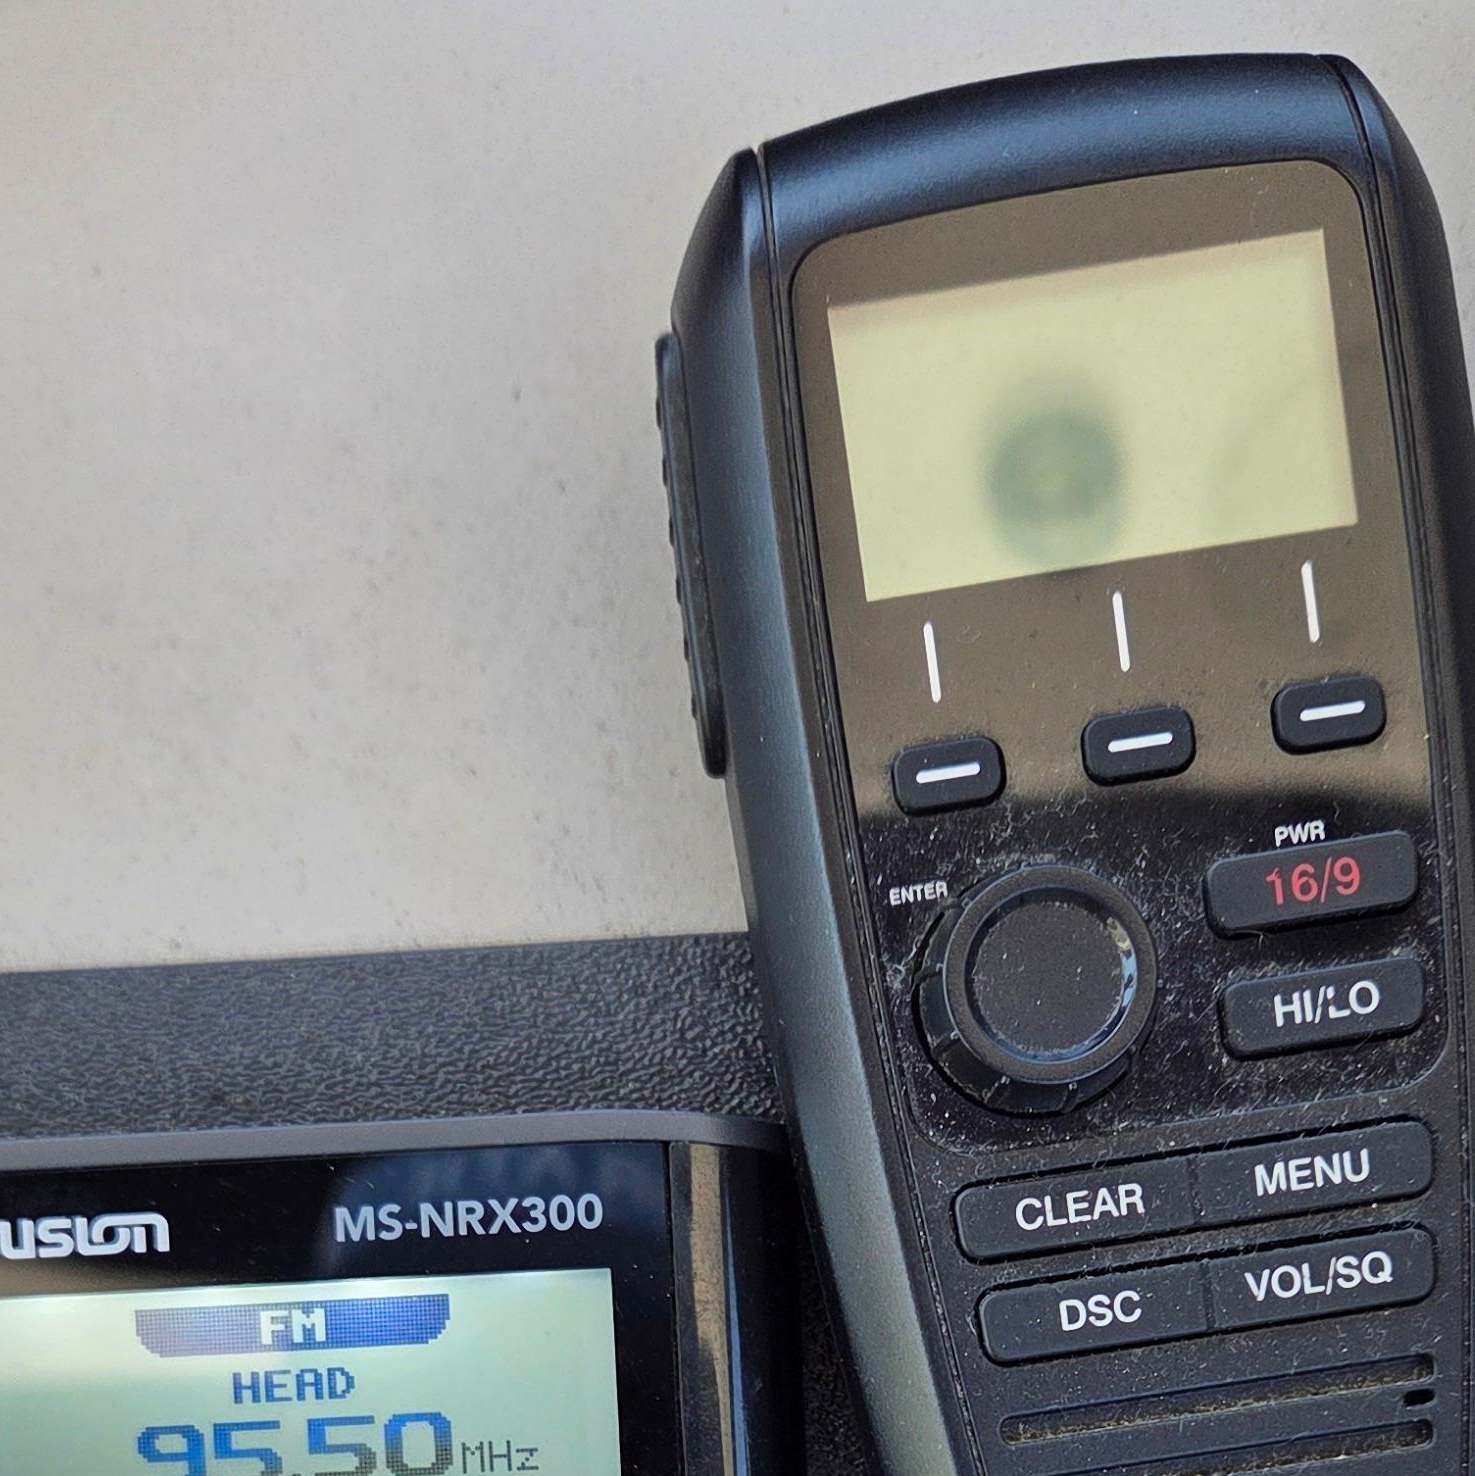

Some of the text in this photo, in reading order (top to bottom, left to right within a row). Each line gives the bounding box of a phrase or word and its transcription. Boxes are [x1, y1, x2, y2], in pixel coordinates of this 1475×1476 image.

[1273, 819, 1326, 847] PWR
[888, 880, 949, 906] ENTER
[1265, 854, 1362, 906] 16/9
[1272, 979, 1381, 1028] HI/LO
[1253, 1148, 1371, 1197] MENU
[333, 1192, 604, 1244] MS-NRX300
[1014, 1182, 1146, 1232] CLEAR
[1244, 1250, 1394, 1303] VOL/SQ
[259, 1306, 327, 1346] FM
[1058, 1289, 1143, 1332] DSC
[232, 1366, 355, 1405] HEAD
[460, 1439, 540, 1475] MHz
